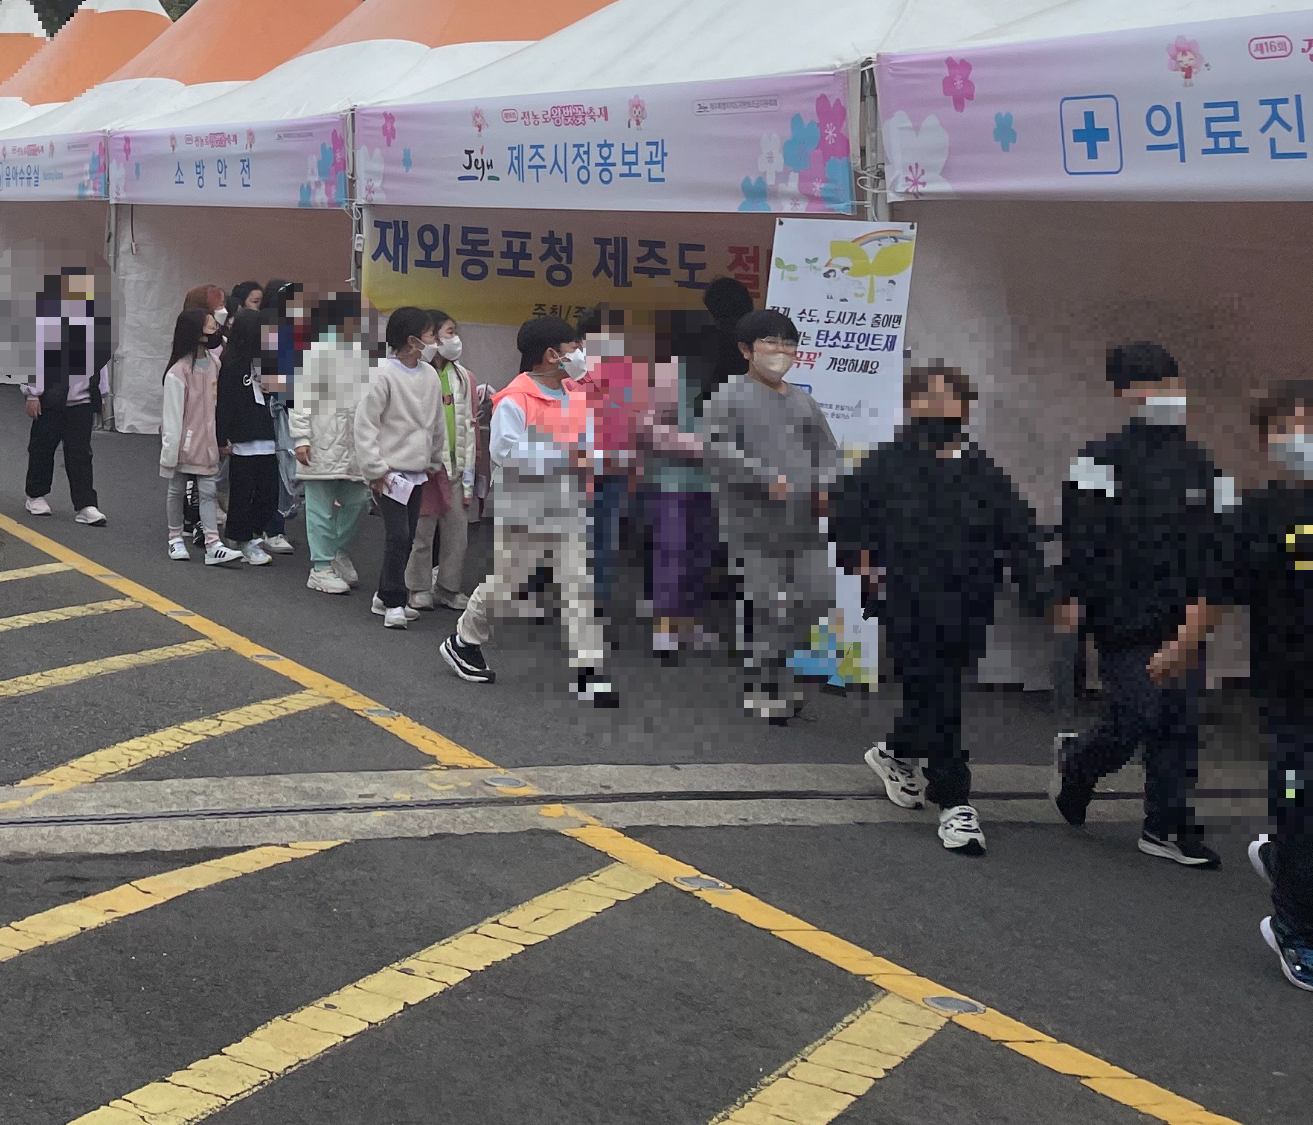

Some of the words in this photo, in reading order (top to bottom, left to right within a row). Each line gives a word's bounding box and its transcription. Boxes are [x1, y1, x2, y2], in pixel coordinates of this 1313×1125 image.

[1252, 40, 1288, 55] 제16회
[507, 139, 668, 185] 제주시정홍보관
[5, 165, 40, 187] 유아수유실
[370, 219, 574, 287] 재외동포청
[592, 236, 711, 289] 제주도
[726, 245, 773, 300] 절
[824, 310, 867, 326] 도시가스
[870, 313, 903, 329] 줄이면
[815, 329, 898, 351] 탄소포인트제
[825, 356, 880, 375] 가입하세요
